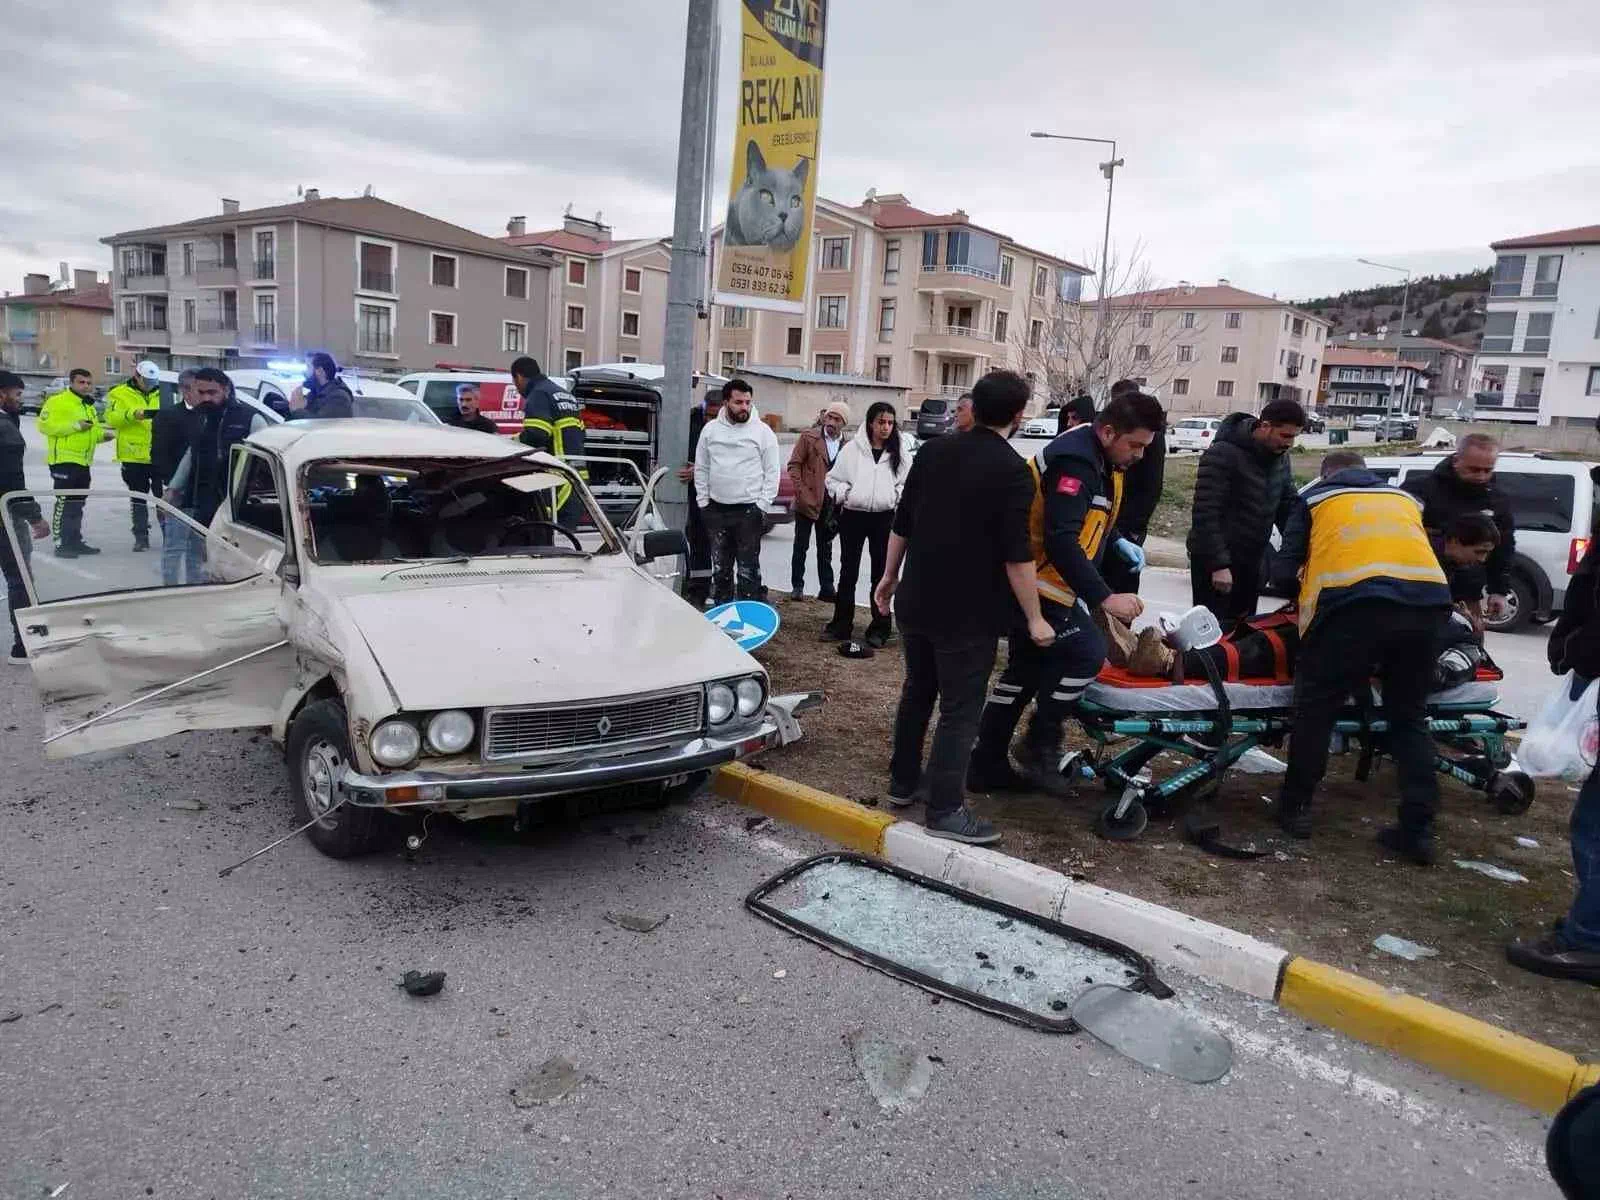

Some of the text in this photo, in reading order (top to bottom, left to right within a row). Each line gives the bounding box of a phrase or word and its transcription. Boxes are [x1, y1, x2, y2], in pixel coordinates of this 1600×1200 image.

[763, 10, 797, 39] REKLAM
[742, 75, 819, 126] REKLAM
[732, 262, 753, 274] 0536
[730, 278, 750, 290] 0531
